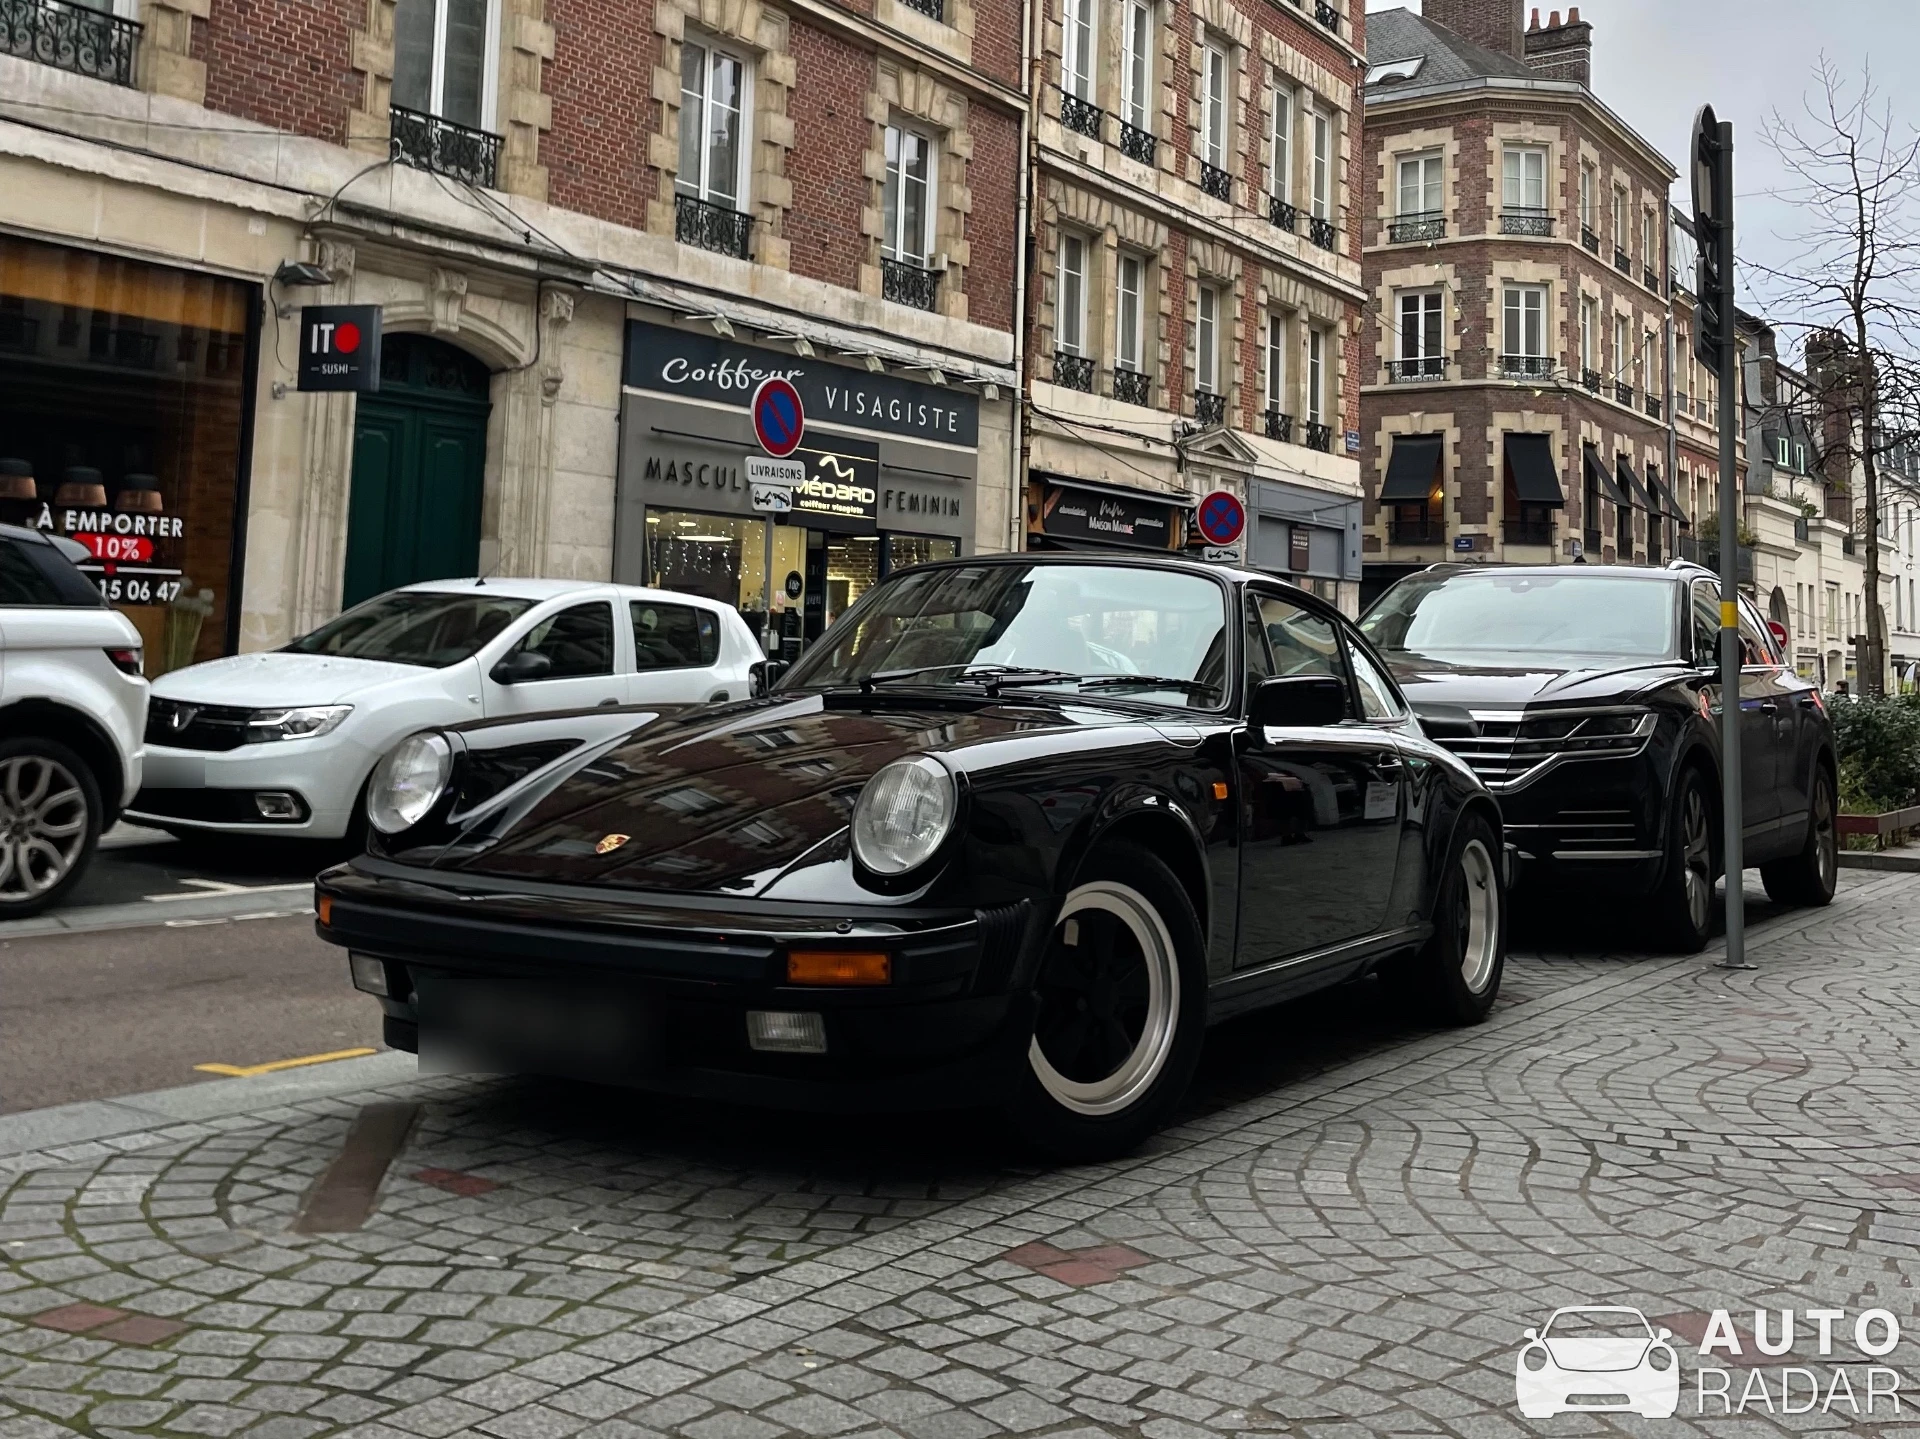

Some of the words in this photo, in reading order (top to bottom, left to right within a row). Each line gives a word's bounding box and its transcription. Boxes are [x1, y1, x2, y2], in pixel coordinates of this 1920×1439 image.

[322, 363, 348, 375] SUSHI
[662, 358, 804, 390] Coiffeur
[825, 386, 958, 432] VISAGISTE
[645, 456, 752, 493] MASCUL
[751, 464, 802, 480] LIVRAISONS
[885, 489, 960, 517] FEMININ
[37, 502, 54, 529] À
[65, 509, 183, 537] EMPORTER
[95, 536, 140, 560] 10%
[127, 580, 150, 601] 06
[156, 581, 181, 601] 47
